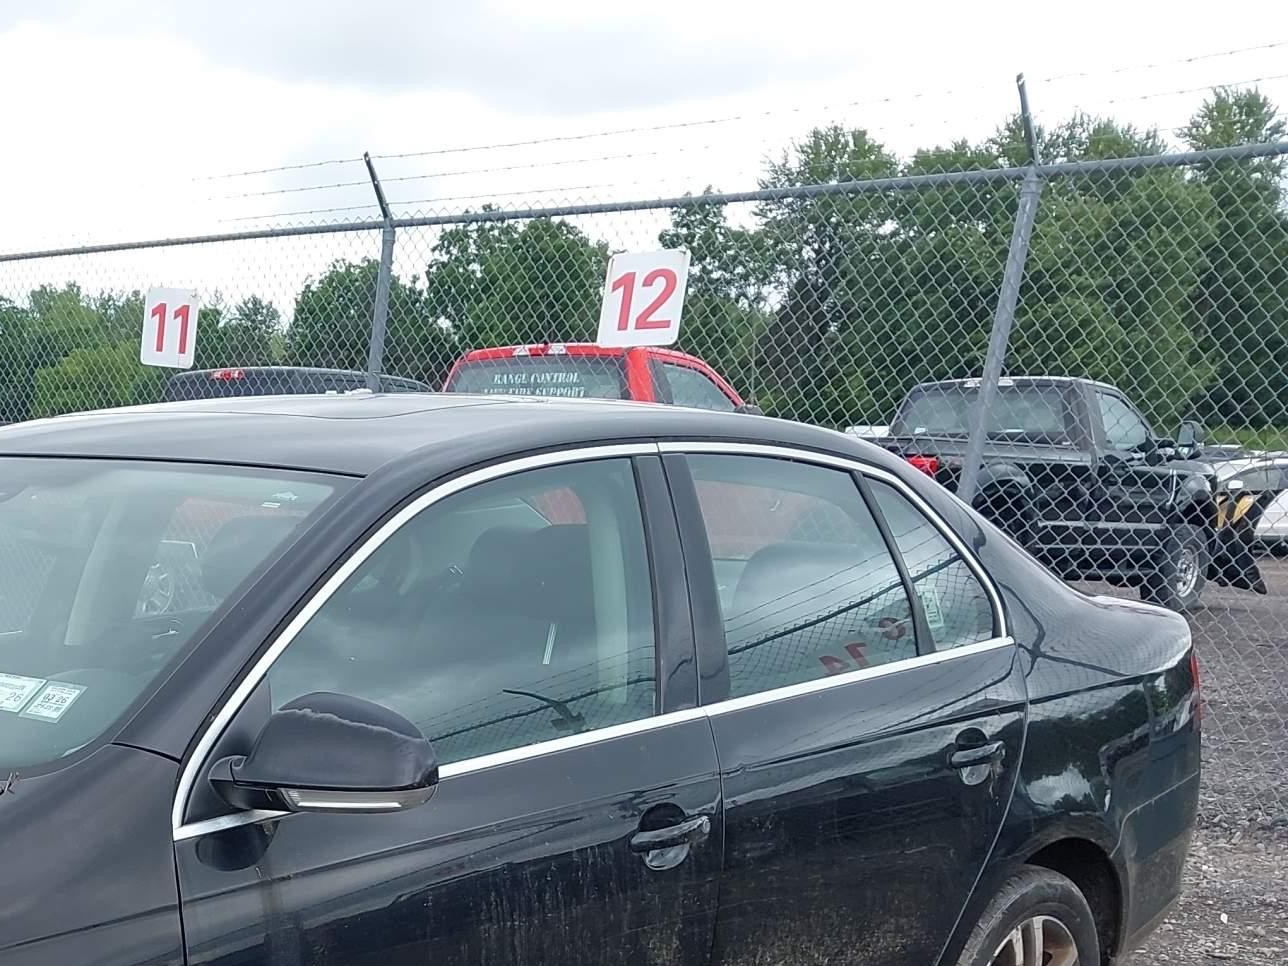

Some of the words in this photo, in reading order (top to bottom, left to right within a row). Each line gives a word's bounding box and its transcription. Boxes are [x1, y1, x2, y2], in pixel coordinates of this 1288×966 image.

[611, 268, 677, 331] 12
[150, 302, 190, 354] 11
[493, 373, 528, 385] RANGE
[530, 372, 580, 384] CONTROL
